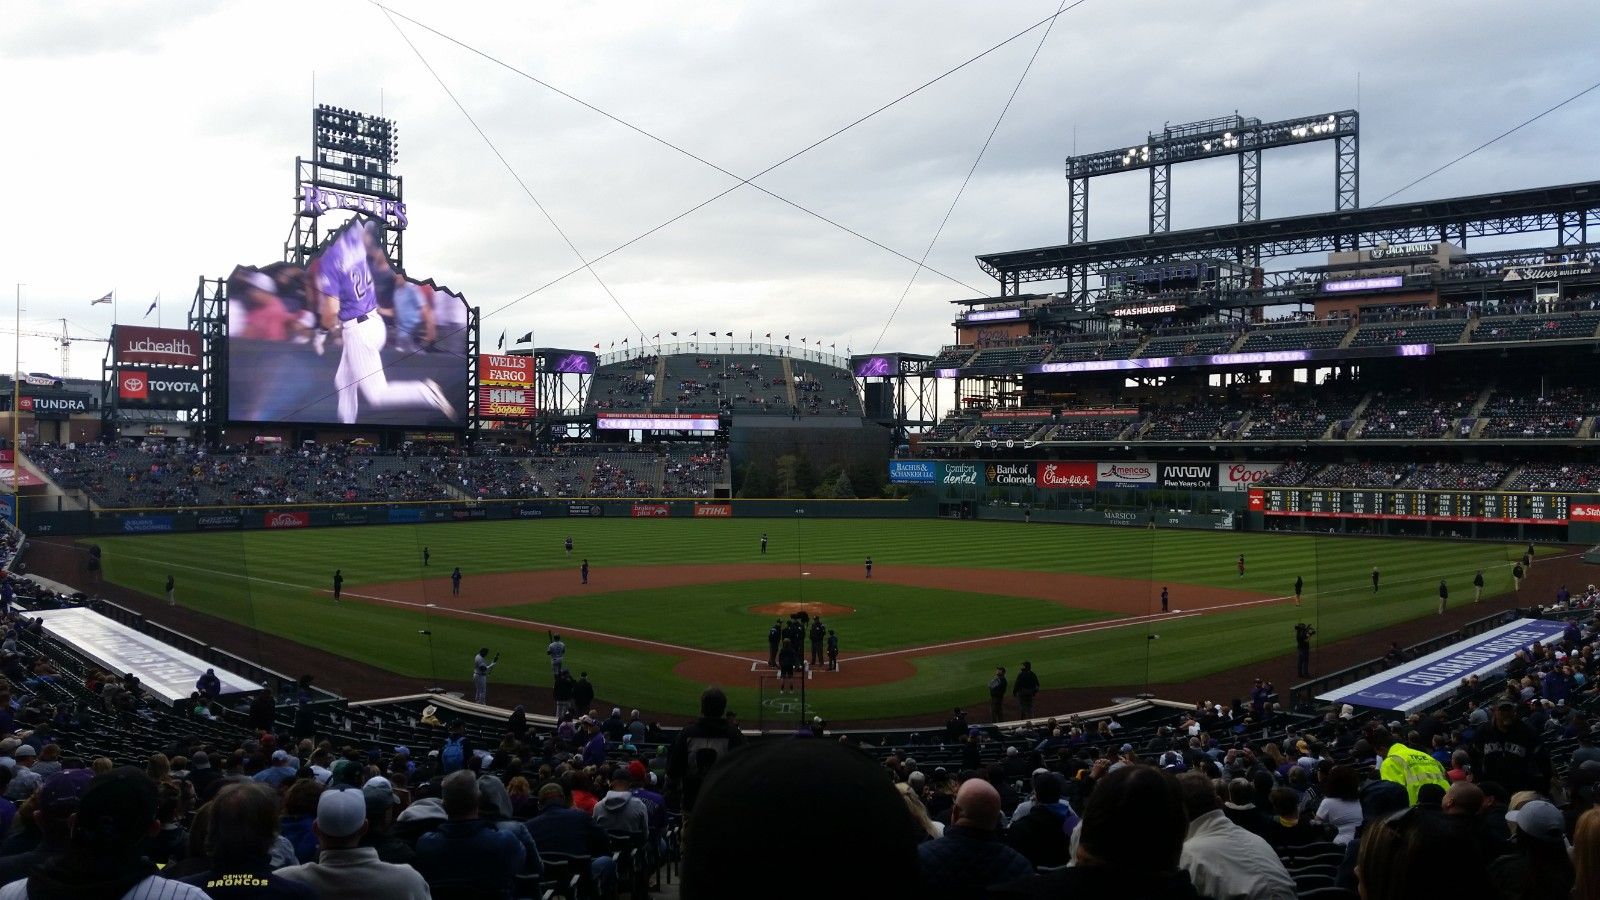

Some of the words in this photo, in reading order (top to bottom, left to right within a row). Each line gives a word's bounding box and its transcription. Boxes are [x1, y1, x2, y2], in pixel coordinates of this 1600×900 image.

[304, 187, 408, 228] ROCKIES
[1386, 244, 1404, 254] JACK
[1523, 268, 1558, 279] Silver
[351, 263, 373, 300] 24
[1114, 305, 1176, 316] SMASHBURGER
[129, 337, 191, 352] uchealth
[489, 357, 525, 369] WELLS
[490, 370, 526, 382] FARGO
[149, 381, 199, 393] TOYOTA
[490, 390, 525, 403] KING
[33, 399, 84, 409] TUNDRA
[489, 403, 526, 415] Soopers
[945, 463, 975, 472] Comfort
[997, 465, 1018, 474] Bank
[1019, 465, 1028, 474] of
[1164, 466, 1211, 477] ARROW
[1229, 464, 1269, 482] Coor
[944, 472, 976, 484] dental
[997, 474, 1035, 484] Colorado
[698, 507, 728, 515] STIHL
[1398, 651, 1497, 686] COLORADO
[1476, 630, 1546, 653] ROCKIES
[207, 879, 268, 888] BRONCOS
